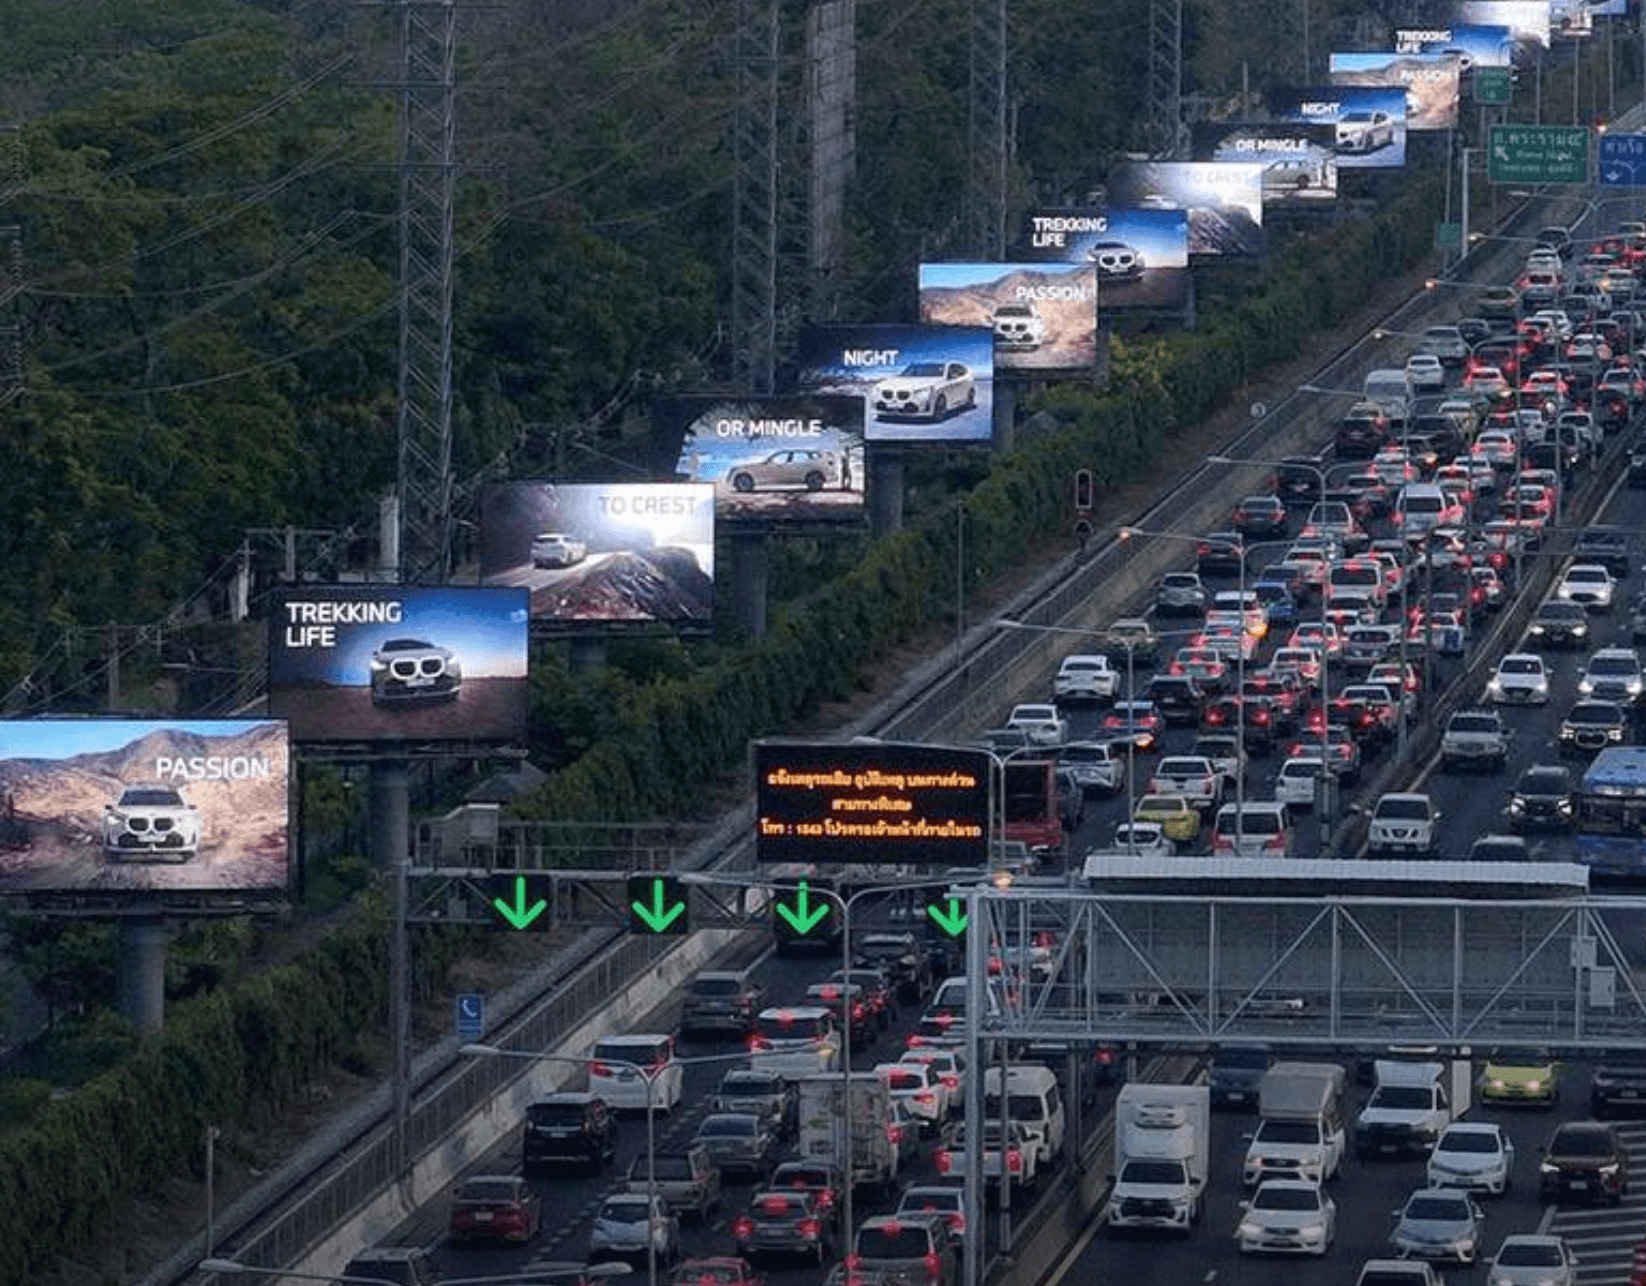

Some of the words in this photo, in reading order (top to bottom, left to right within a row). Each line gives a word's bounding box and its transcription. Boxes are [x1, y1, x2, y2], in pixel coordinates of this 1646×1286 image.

[1301, 102, 1340, 116] NIGHT
[1236, 138, 1256, 152] OR
[1258, 138, 1308, 152] MINGLE
[1033, 217, 1107, 232] TREKKING
[1033, 233, 1065, 247] LIFE
[1016, 285, 1086, 301] PASSION
[844, 349, 899, 366] NIGHT
[717, 419, 746, 438] OR
[750, 419, 822, 438] MINGLE
[599, 495, 627, 515] TO
[632, 495, 697, 515] CREST
[286, 601, 402, 624] TREKKING
[286, 626, 336, 648] LIFE
[157, 756, 270, 780] PASSION
